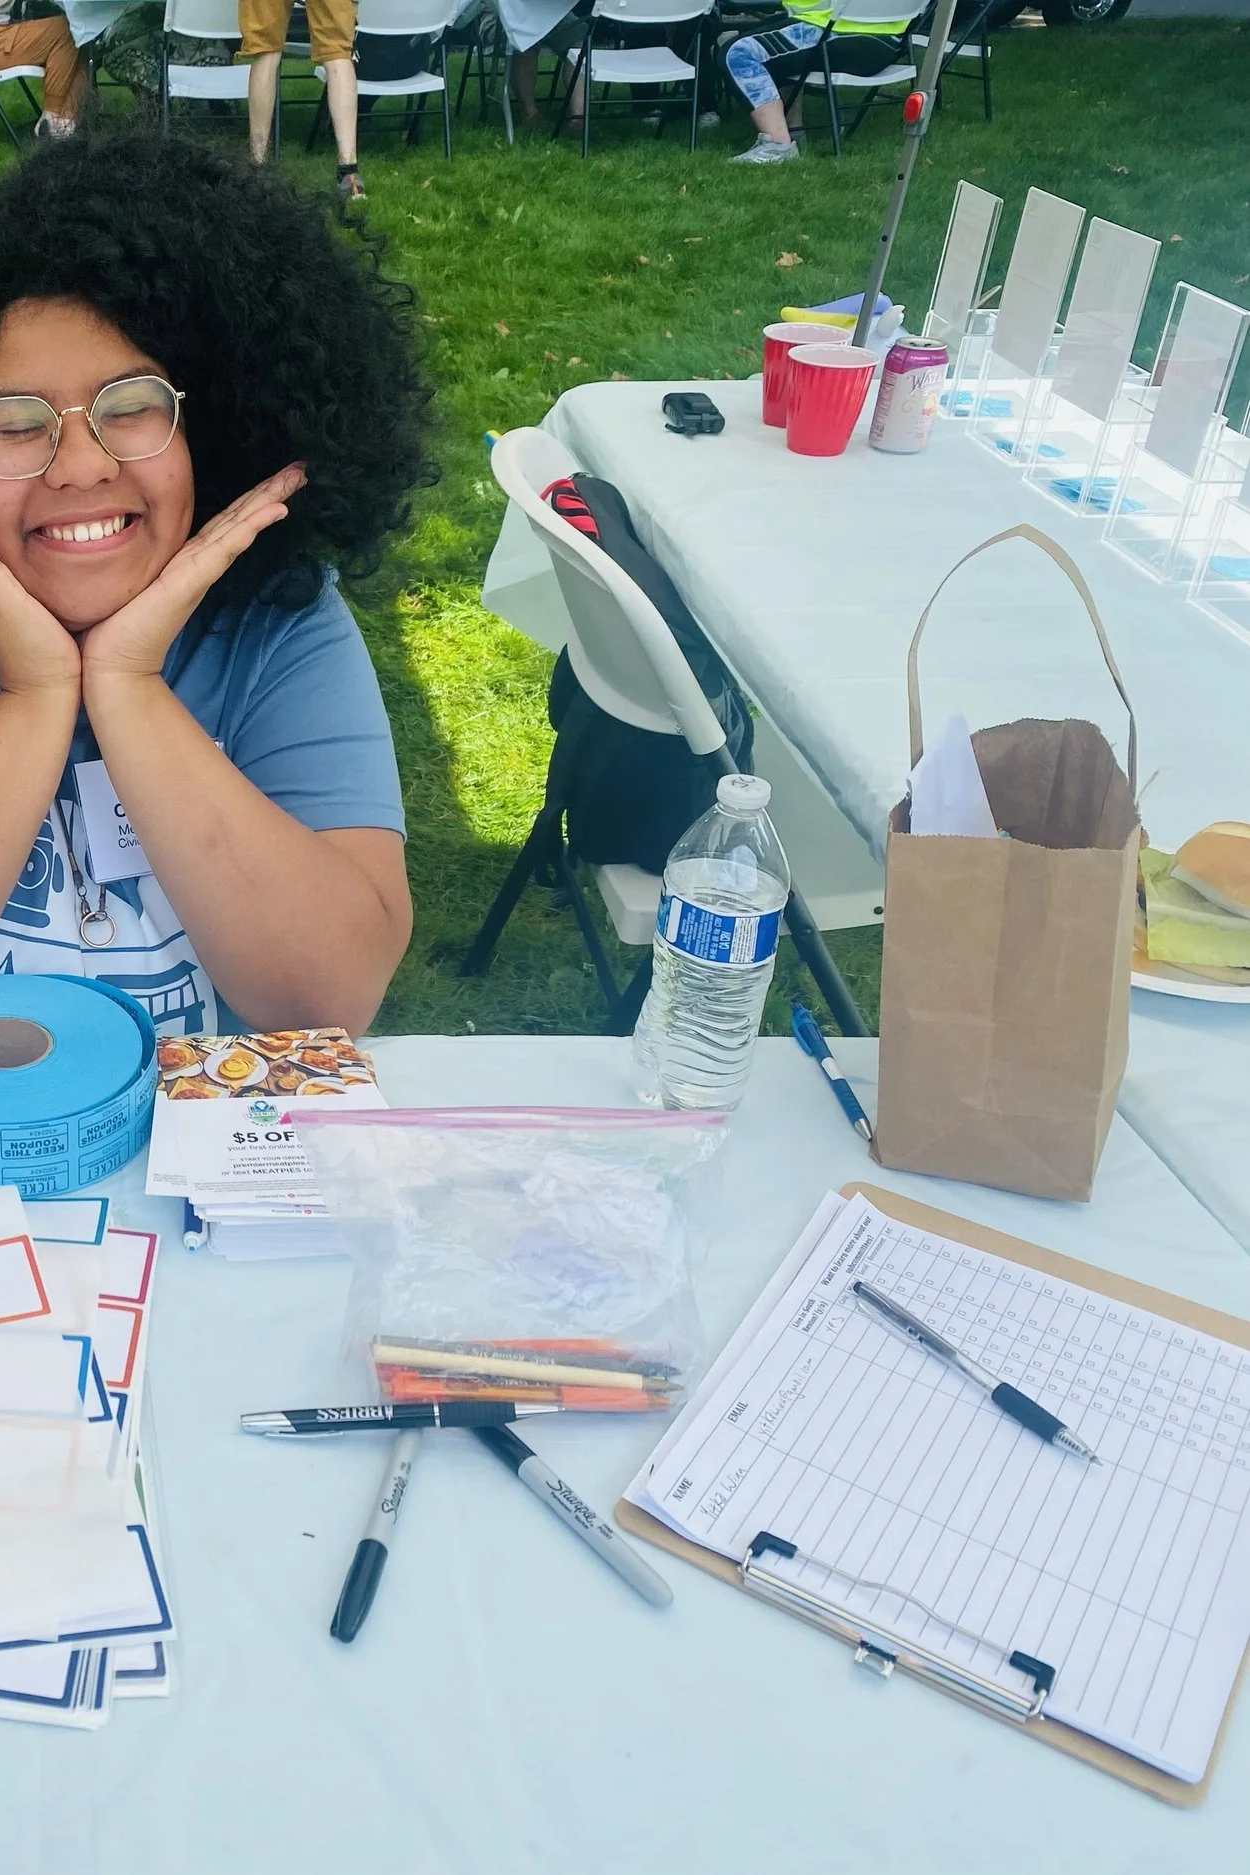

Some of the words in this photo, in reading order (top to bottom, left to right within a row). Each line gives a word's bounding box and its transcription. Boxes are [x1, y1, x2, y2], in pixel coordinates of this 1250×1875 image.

[86, 1112, 124, 1135] COUPON
[106, 1116, 127, 1135] KEEP
[10, 1138, 59, 1149] COUPON
[81, 1132, 103, 1145] THIS
[233, 1131, 259, 1144] $5
[265, 1131, 296, 1143] OF
[4, 1149, 30, 1157] THIS
[35, 1144, 65, 1155] KEEP
[269, 1143, 295, 1151] online
[87, 1149, 124, 1181] TICKET
[20, 1180, 57, 1195] TICKE
[821, 1270, 836, 1287] Want
[837, 1251, 849, 1267] learn
[844, 1240, 857, 1255] more
[853, 1224, 867, 1241] about
[862, 1216, 872, 1227] our
[845, 1234, 875, 1275] subcommittees?
[316, 1406, 383, 1422] BRIESS
[727, 1401, 748, 1423] EMAIL
[672, 1477, 693, 1502] NAME
[546, 1477, 596, 1528] Sharpie
